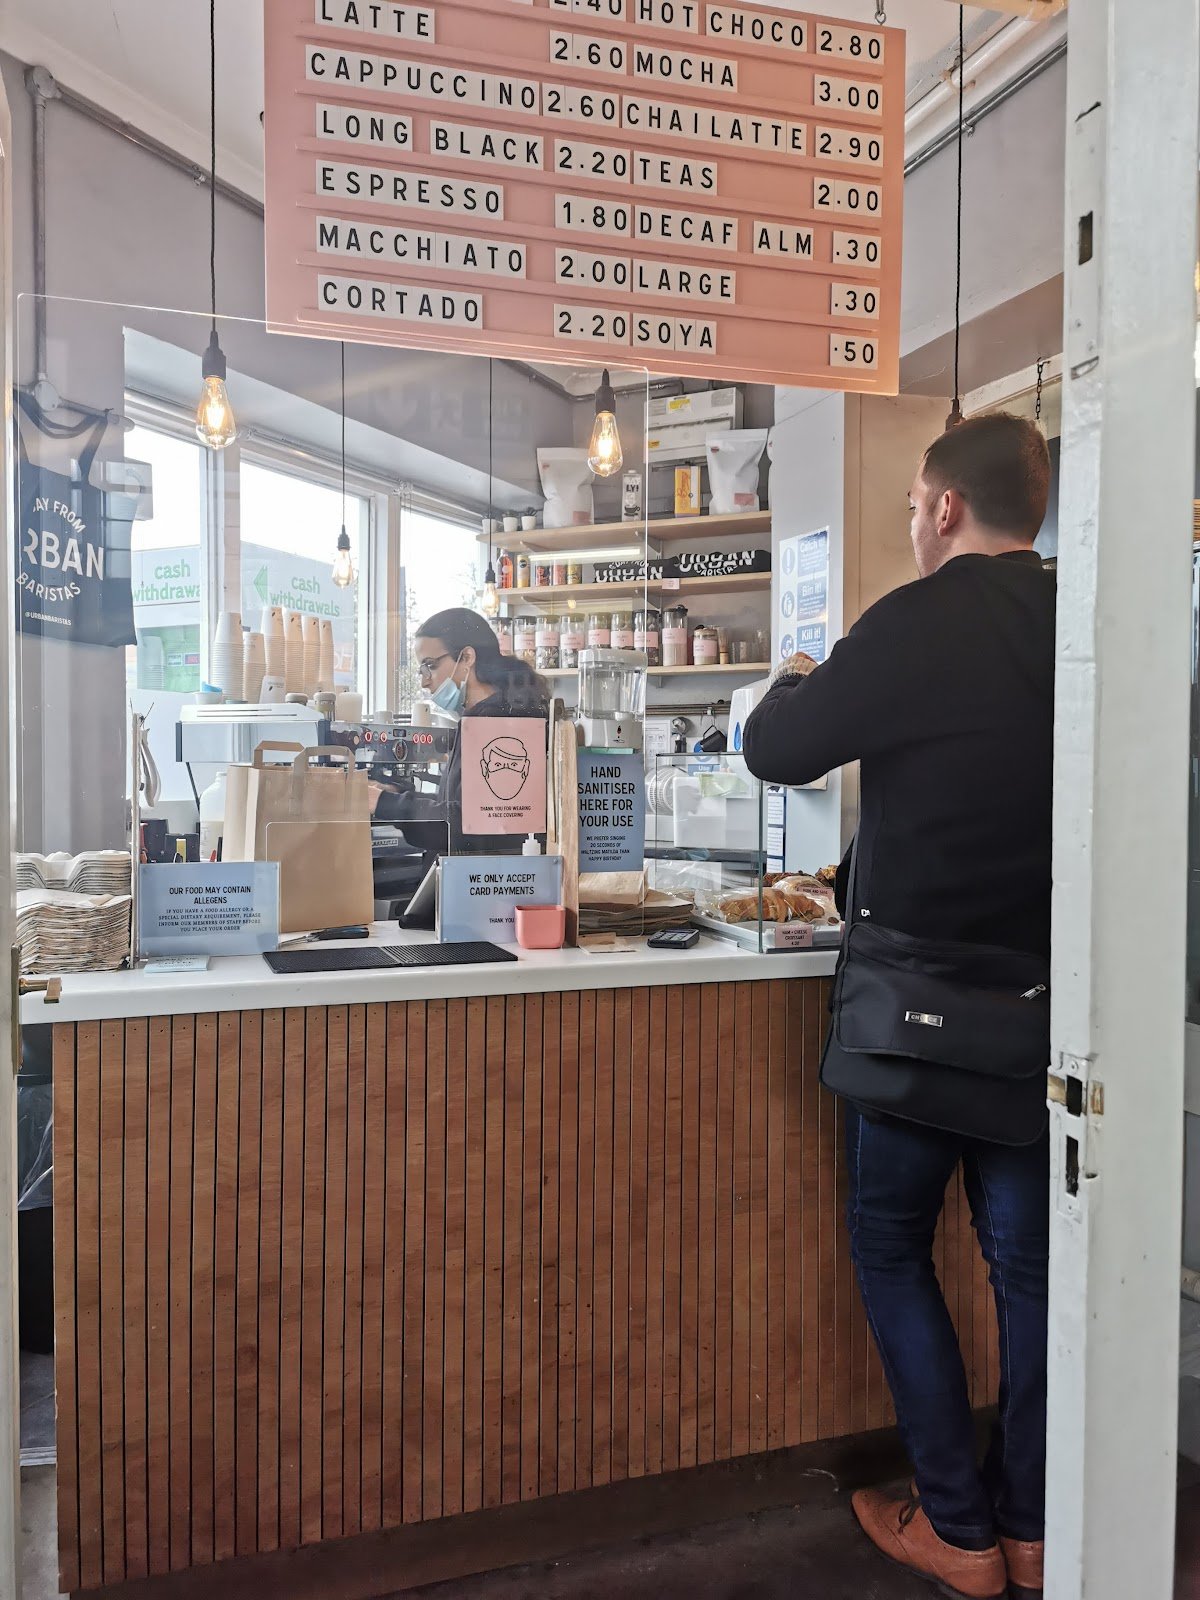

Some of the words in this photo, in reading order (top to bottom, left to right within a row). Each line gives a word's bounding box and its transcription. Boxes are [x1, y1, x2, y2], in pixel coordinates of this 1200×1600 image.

[554, 0, 621, 15] .40
[322, 0, 429, 37] LATTE
[555, 38, 622, 69] 2.60
[640, 0, 693, 27] HOT
[710, 12, 803, 47] CHOCO
[821, 31, 880, 59] 2.80
[311, 52, 535, 109] CAPPUCCINO
[548, 90, 615, 120] 2.60
[637, 51, 733, 87] MOCHA
[819, 82, 879, 110] 3.00
[323, 110, 408, 144] LONG
[435, 128, 539, 164] BLACK
[559, 146, 627, 176] 2.20
[627, 103, 802, 150] CHAILATTE
[820, 133, 880, 161] 2.90
[322, 167, 499, 213] ESPRESSO
[563, 202, 627, 231] 1.80
[639, 158, 713, 189] TEAS
[818, 184, 878, 211] 2.00
[640, 211, 733, 244] DECAF
[758, 228, 811, 255] ALM
[836, 239, 878, 263] .30
[319, 223, 522, 272] MACCHIATO
[560, 255, 627, 285] 2.00
[639, 265, 731, 298] LARGE
[834, 290, 876, 314] .30
[323, 281, 478, 322] CORTADO
[559, 311, 626, 338] 2.20
[637, 320, 713, 349] SOYA
[53, 500, 87, 533] FROM
[22, 527, 104, 581] RBAN
[154, 558, 191, 579] cash
[679, 550, 755, 573] URBAN
[16, 572, 81, 602] BARISTAS
[291, 576, 321, 595] cash
[802, 585, 814, 597] Bin
[270, 591, 340, 617] withdrawals
[801, 629, 813, 641] Kill
[813, 627, 821, 639] it!
[591, 766, 621, 778] HAND
[577, 782, 636, 795] SANITISER
[580, 799, 609, 811] HERE
[612, 799, 633, 811] FOR
[579, 815, 609, 827] YOUR
[612, 815, 634, 827] USE
[169, 887, 184, 895] OUR
[185, 887, 204, 895] FOOD
[205, 886, 221, 894] MAY
[222, 886, 252, 894] CONTAIN
[469, 874, 482, 883] WE
[484, 874, 504, 883] ONLY
[506, 874, 536, 883] ACCEPT
[469, 887, 491, 896] CARD
[493, 886, 535, 895] PAYMENTS
[193, 896, 228, 905] ALLEGENS
